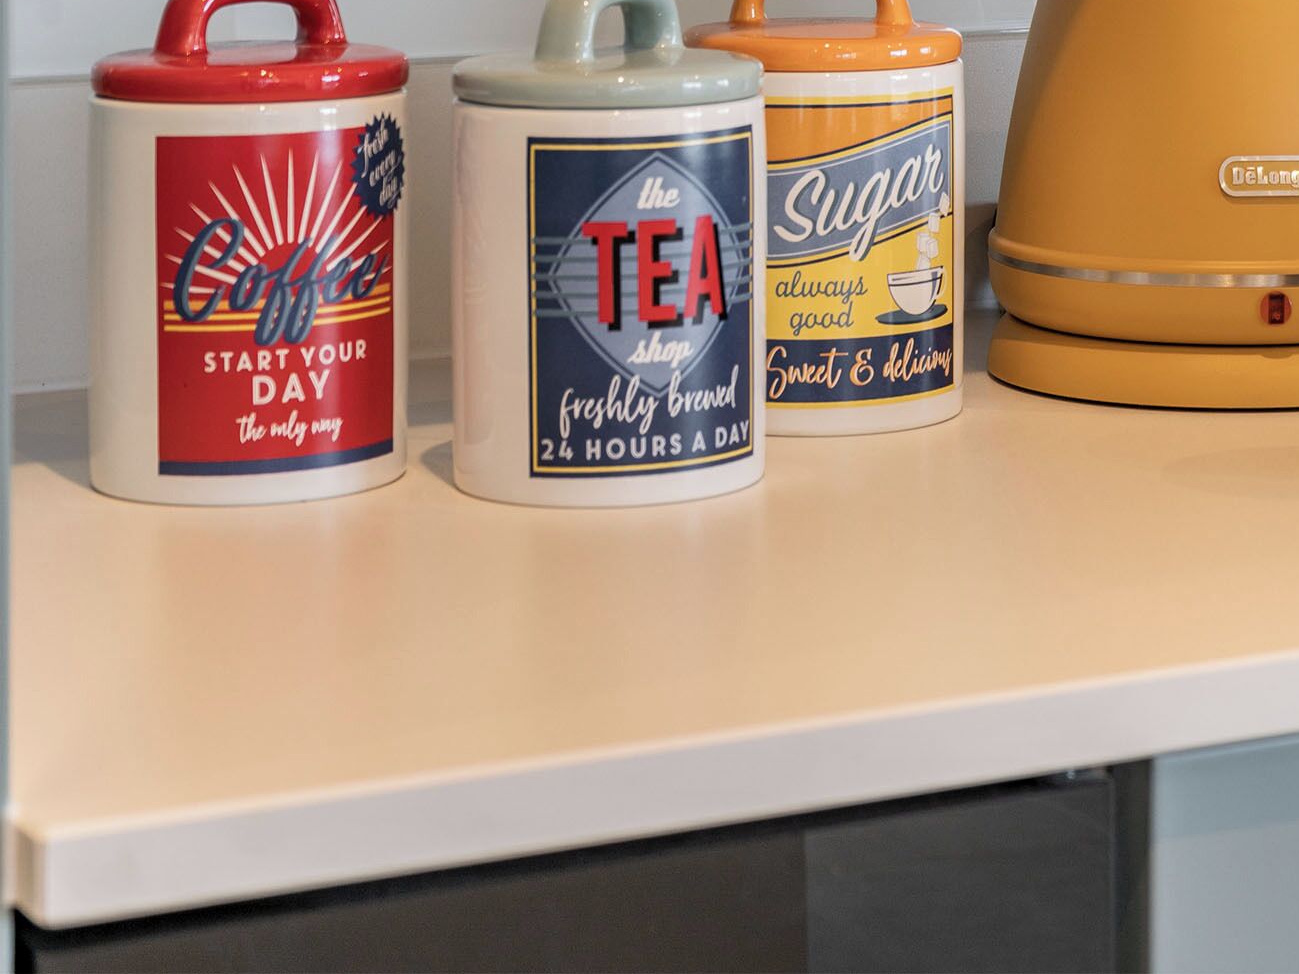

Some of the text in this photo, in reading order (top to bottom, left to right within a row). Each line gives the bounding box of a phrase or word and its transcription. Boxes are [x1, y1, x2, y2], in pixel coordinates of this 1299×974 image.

[357, 118, 389, 178] fresh
[637, 177, 681, 210] the
[773, 143, 945, 262] Sugar
[173, 217, 390, 346] Coffee
[581, 214, 728, 331] TEA
[775, 270, 868, 305] always
[789, 300, 855, 336] good
[204, 339, 367, 373] START YOUR
[627, 330, 695, 369] shop
[766, 345, 849, 400] Sweet
[882, 337, 953, 383] delicious
[252, 369, 331, 406] DAY
[559, 364, 740, 440] freshly brewed
[236, 410, 344, 446] the only way
[541, 419, 750, 461] 24 HOURS A DAY
